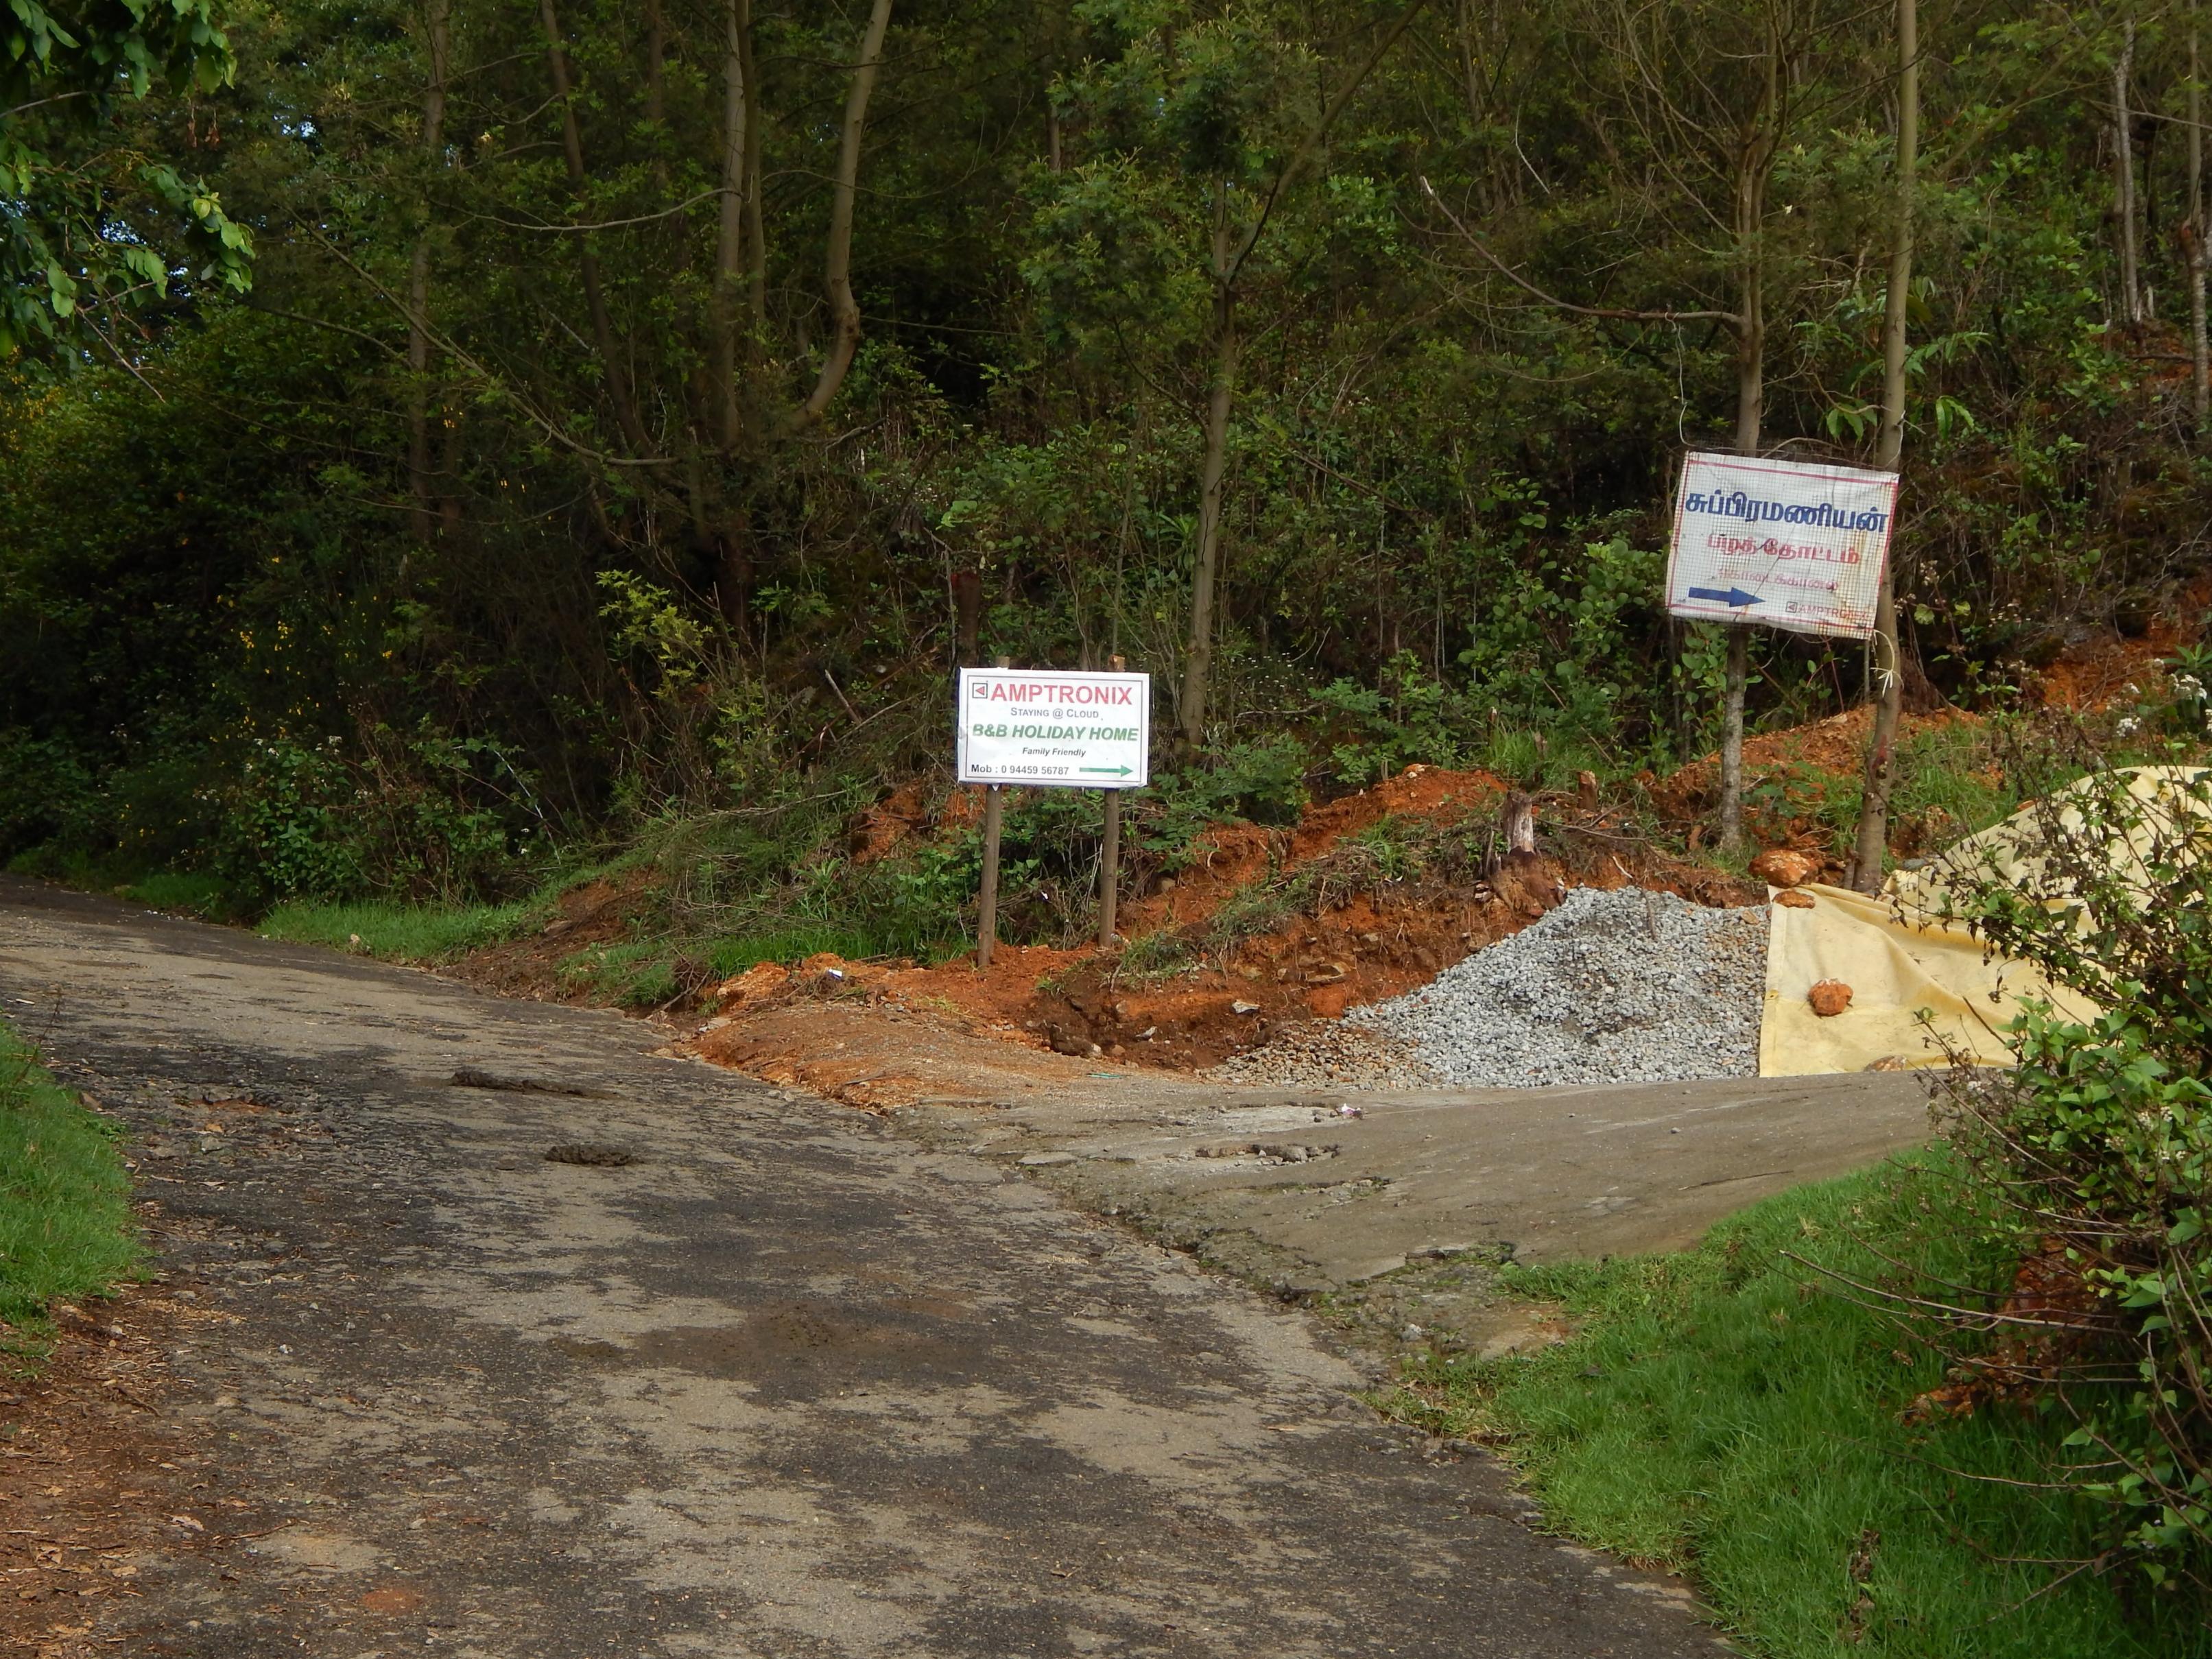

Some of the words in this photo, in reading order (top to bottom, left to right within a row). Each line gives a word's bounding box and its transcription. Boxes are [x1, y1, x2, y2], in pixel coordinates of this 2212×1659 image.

[1685, 489, 1889, 533] சுப்பிரமணியன்
[1762, 537, 1862, 564] தோட்டம்
[990, 683, 1132, 705] AMPTRONIX
[1010, 707, 1049, 717] STAYING
[1052, 708, 1064, 719] @
[1066, 708, 1099, 718] CLOUD
[973, 723, 1007, 737] B&B
[1012, 725, 1086, 739] HOLIDAY
[1089, 727, 1139, 741] HOME
[1022, 747, 1050, 756] Family
[1052, 748, 1086, 757] Friendly
[971, 764, 992, 773] Mob
[1001, 765, 1007, 774] 0
[1010, 765, 1038, 774] 94459
[1041, 766, 1069, 775] 56787
